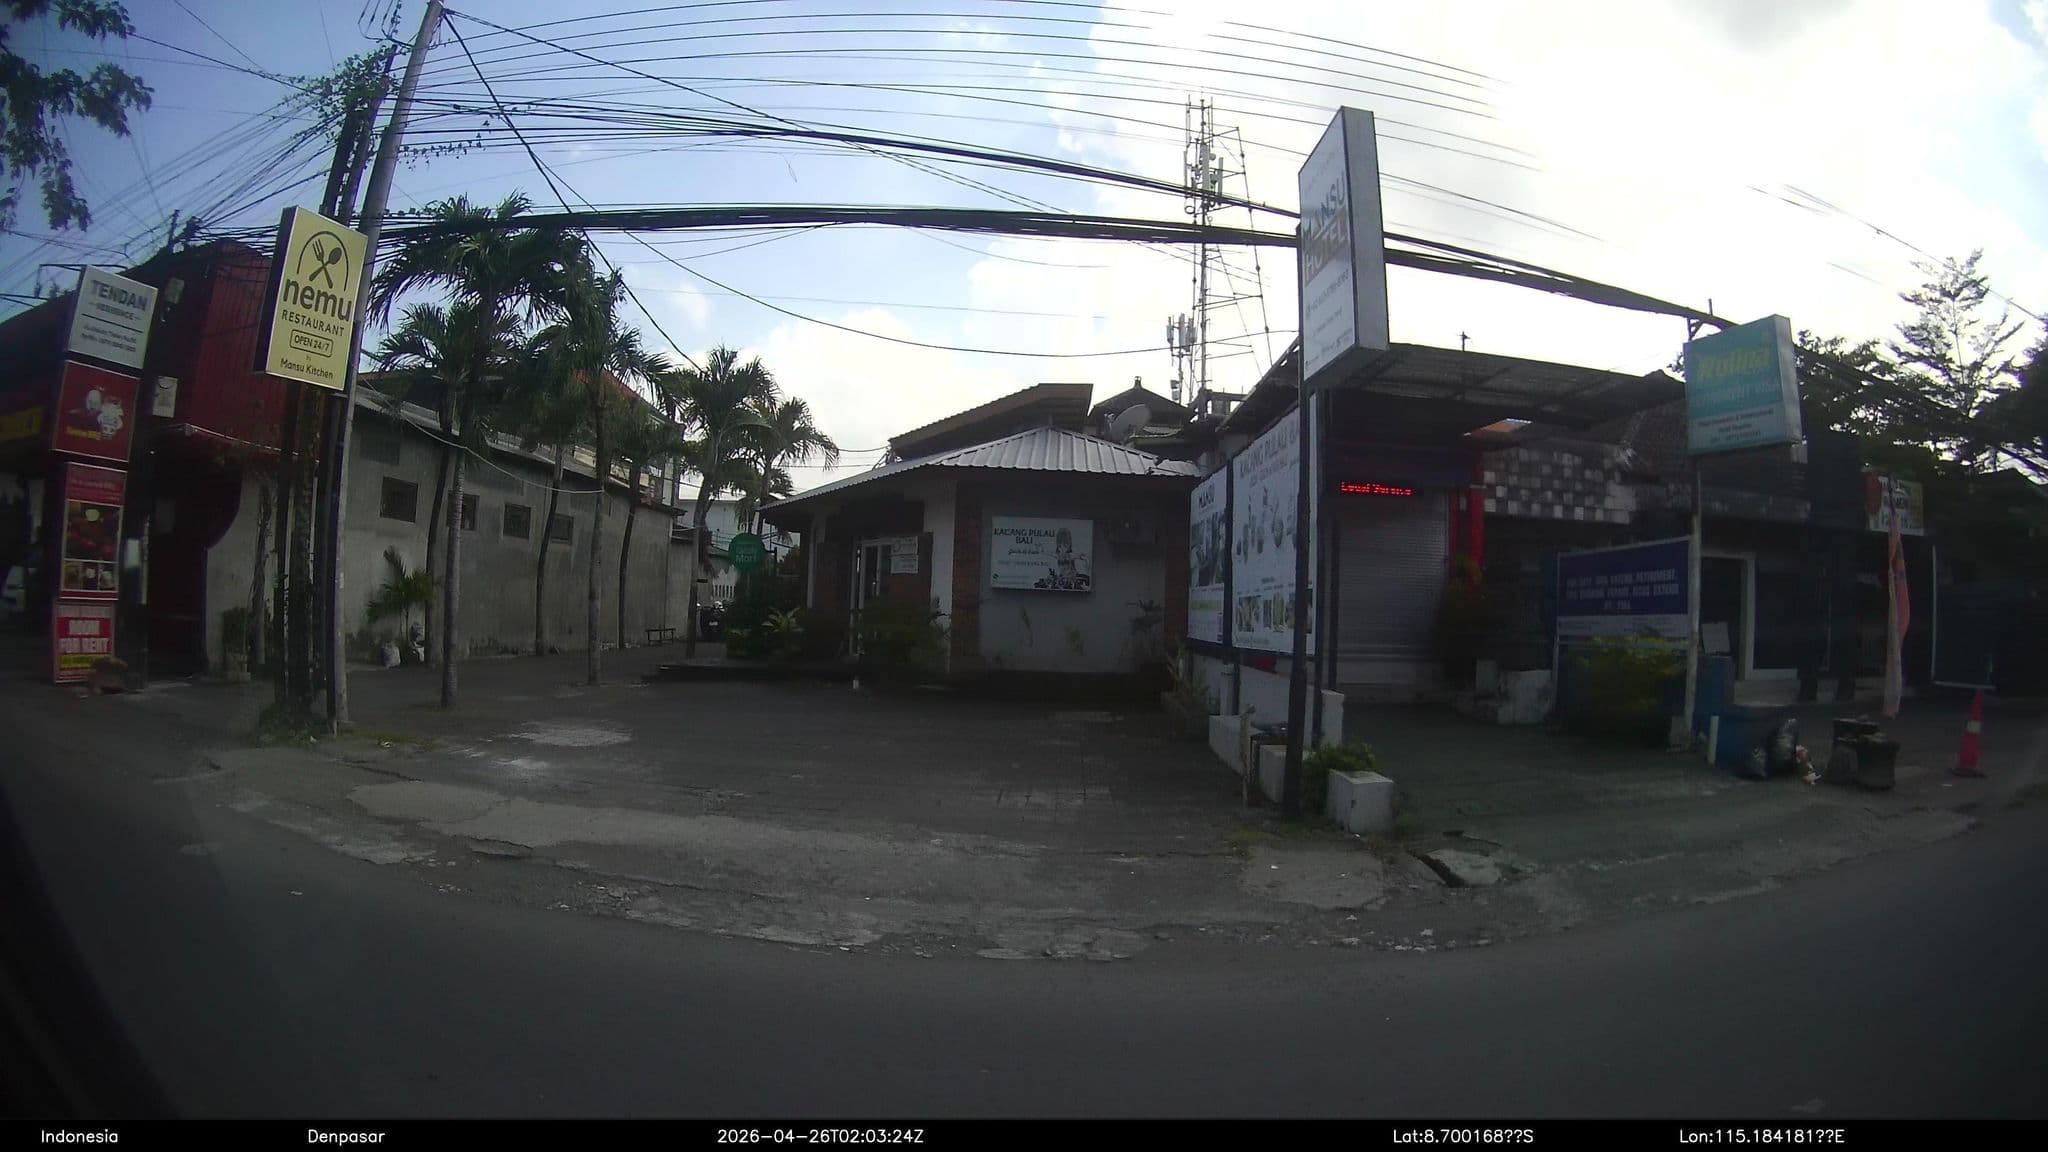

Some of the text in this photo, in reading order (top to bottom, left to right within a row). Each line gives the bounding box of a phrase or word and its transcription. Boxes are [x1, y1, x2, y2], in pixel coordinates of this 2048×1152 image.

[283, 278, 352, 322] nemu
[282, 309, 345, 337] RESTAURANT
[294, 335, 330, 351] OPEN 24/7
[280, 357, 334, 380] Mansu Kitchen
[994, 528, 1056, 538] KACANG PULAU
[1016, 536, 1033, 545] BALI
